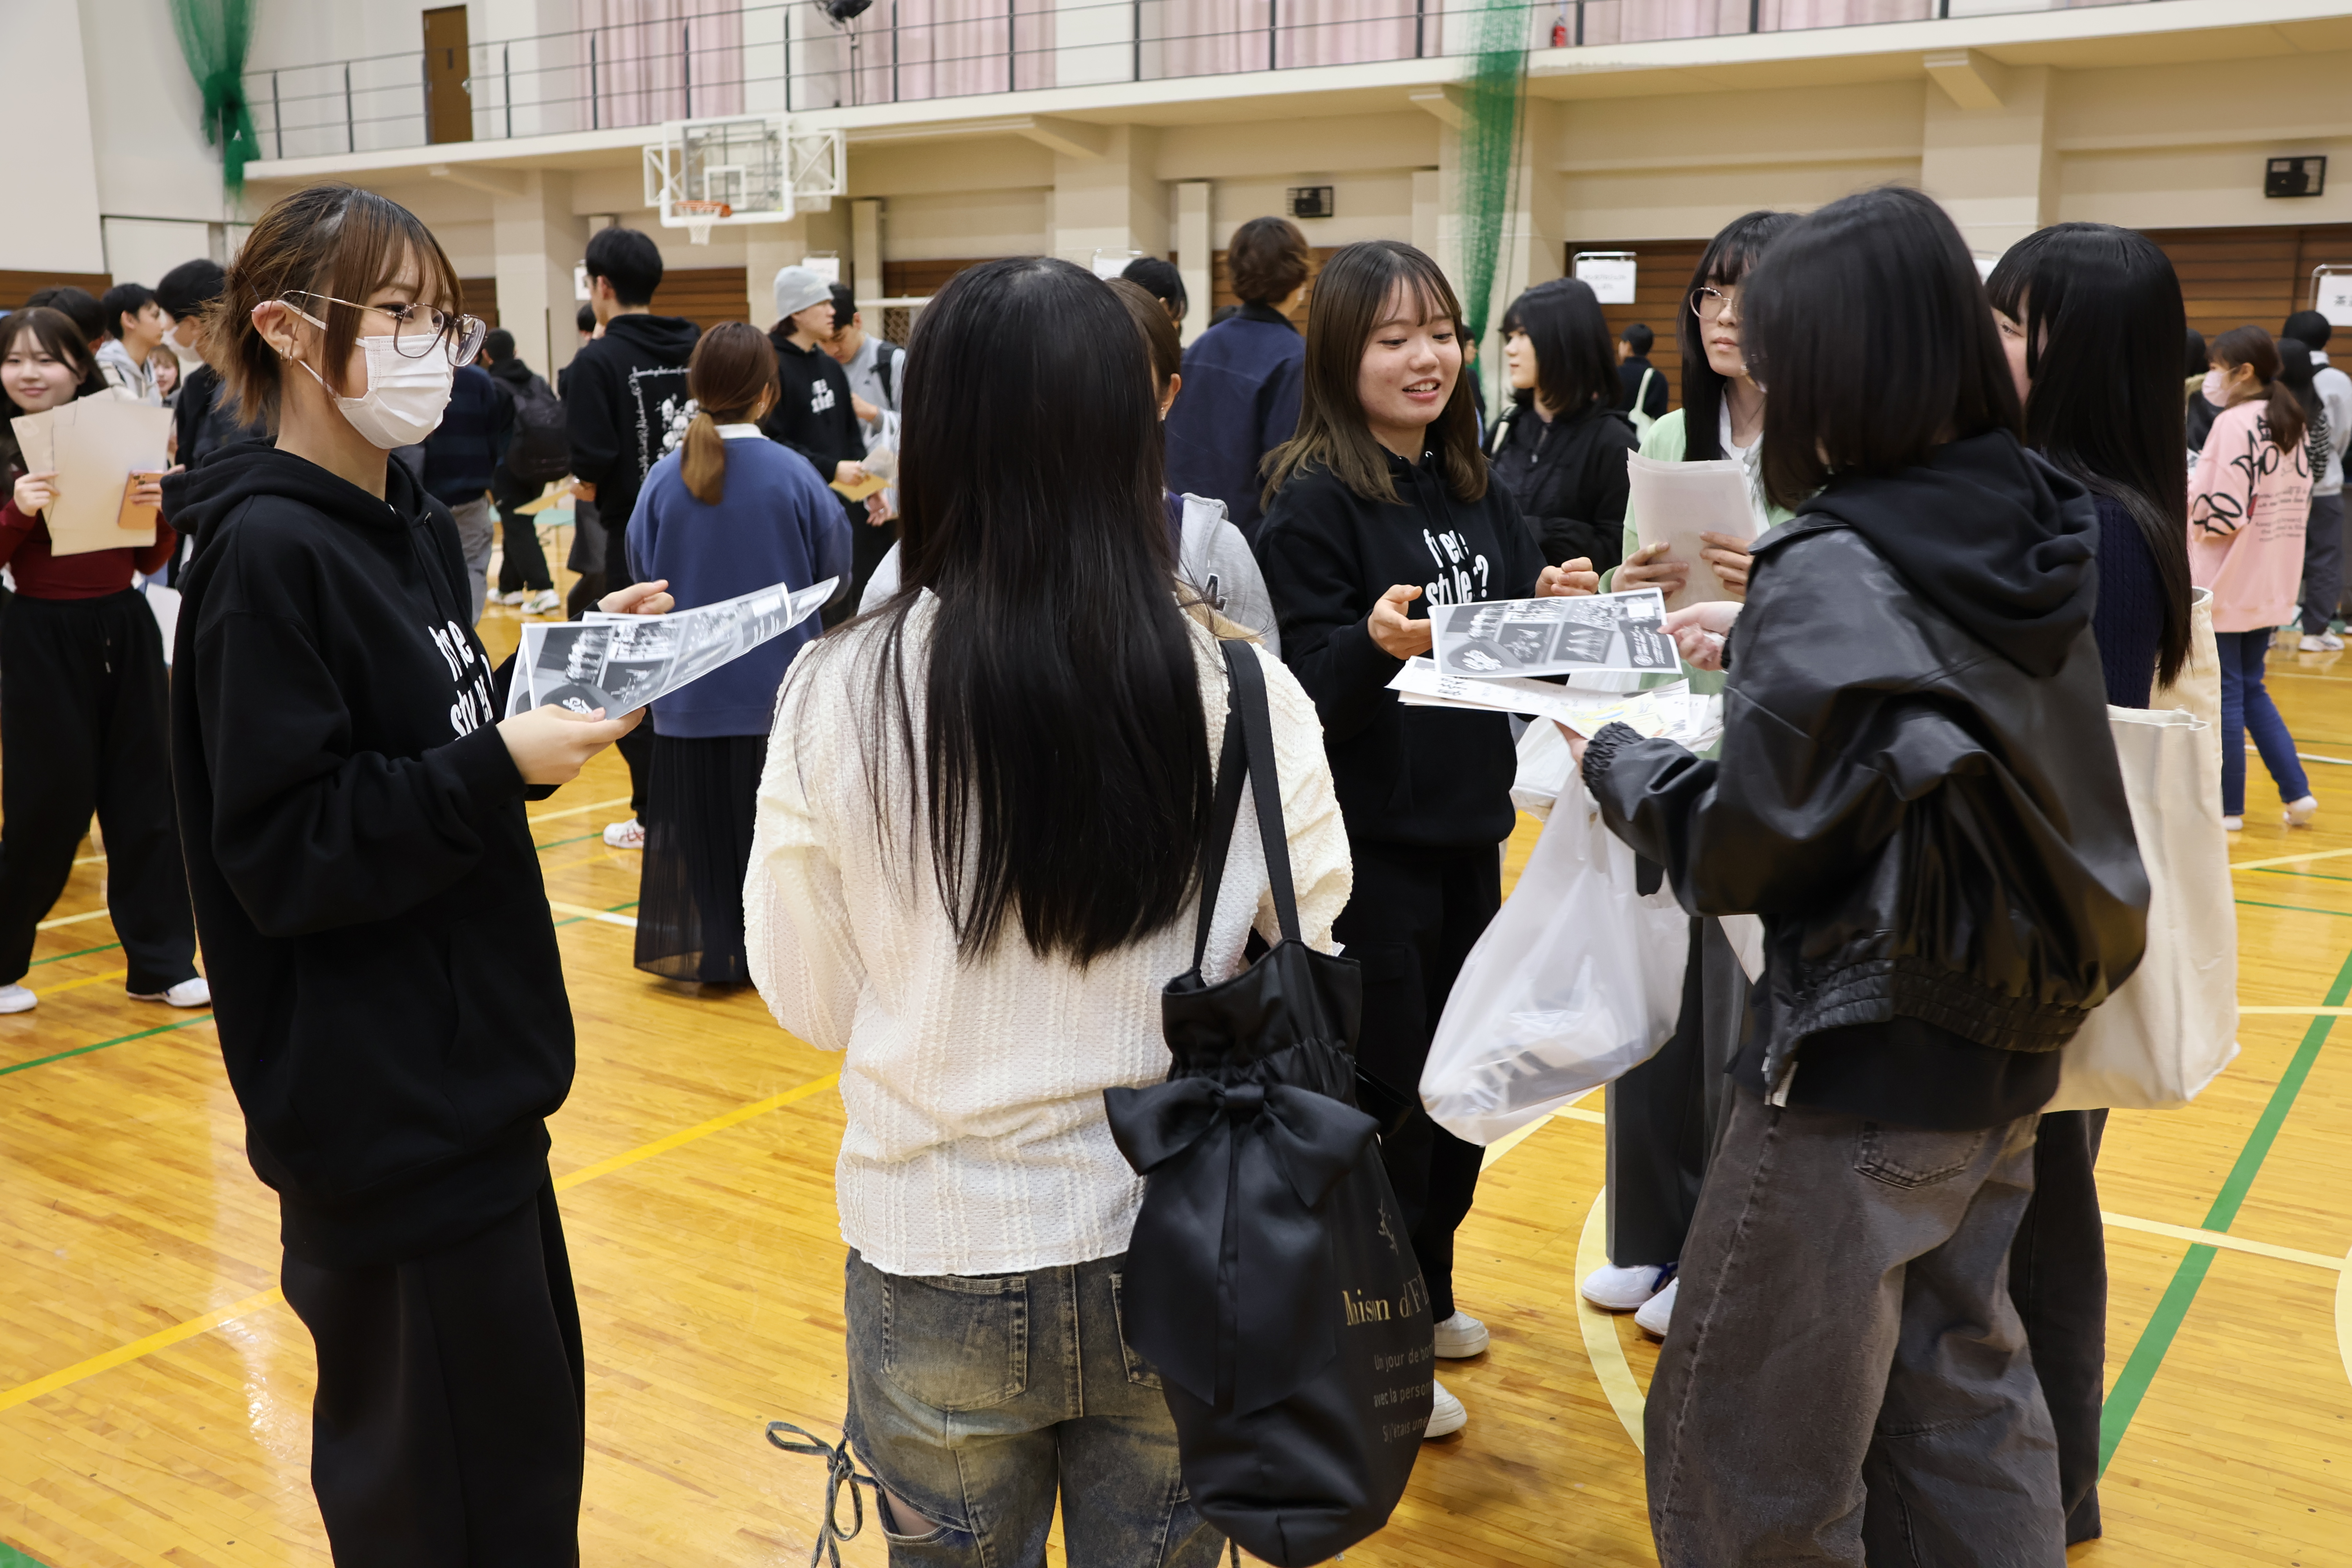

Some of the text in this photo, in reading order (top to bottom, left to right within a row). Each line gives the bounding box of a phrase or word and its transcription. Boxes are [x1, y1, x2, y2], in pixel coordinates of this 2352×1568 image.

[1385, 1353, 1405, 1372] jour
[1408, 1348, 1419, 1364] de
[1373, 1392, 1388, 1408] avec
[1390, 1388, 1397, 1403] la
[1412, 1416, 1428, 1431] une
